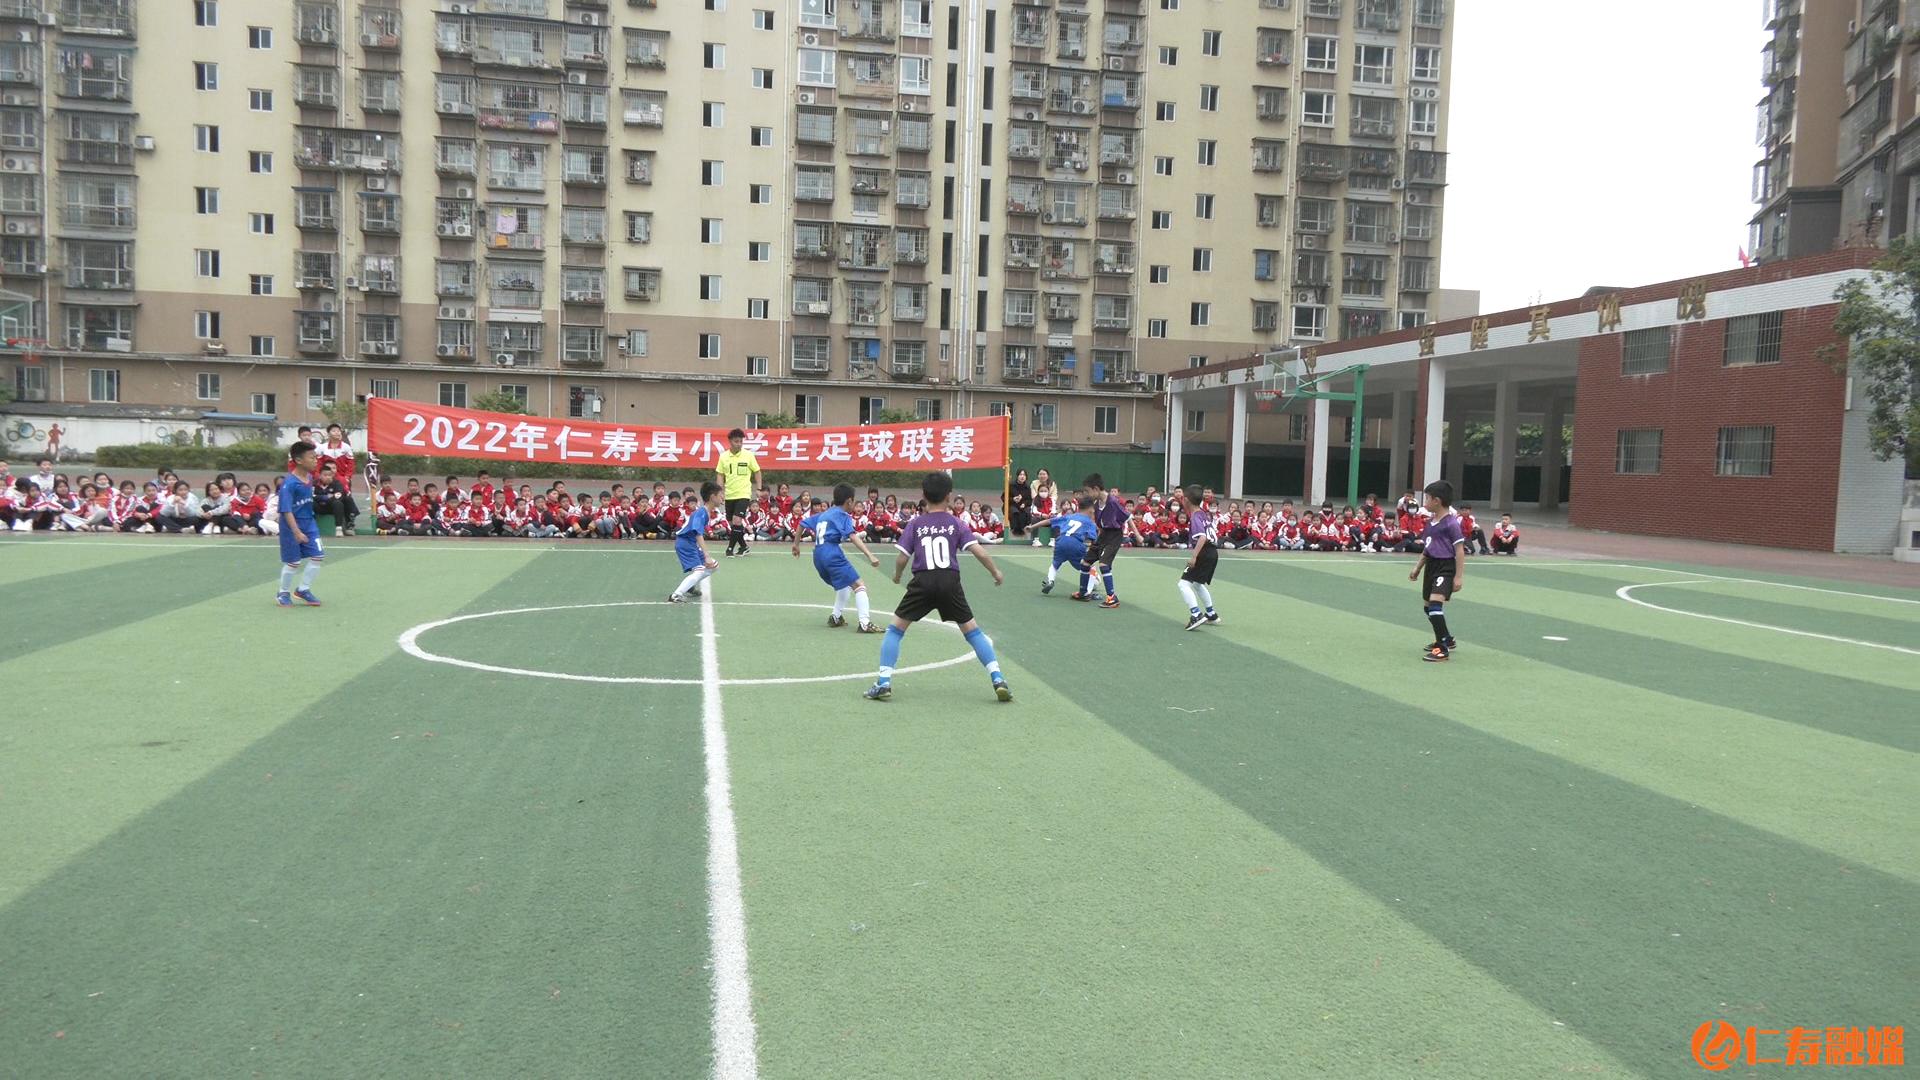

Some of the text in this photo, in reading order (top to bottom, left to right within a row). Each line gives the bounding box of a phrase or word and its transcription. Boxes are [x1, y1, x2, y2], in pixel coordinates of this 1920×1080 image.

[402, 412, 975, 463] 2022年仁寿县小学生足球联赛
[1065, 519, 1082, 536] 7
[920, 536, 951, 570] 10
[1436, 576, 1444, 587] 9
